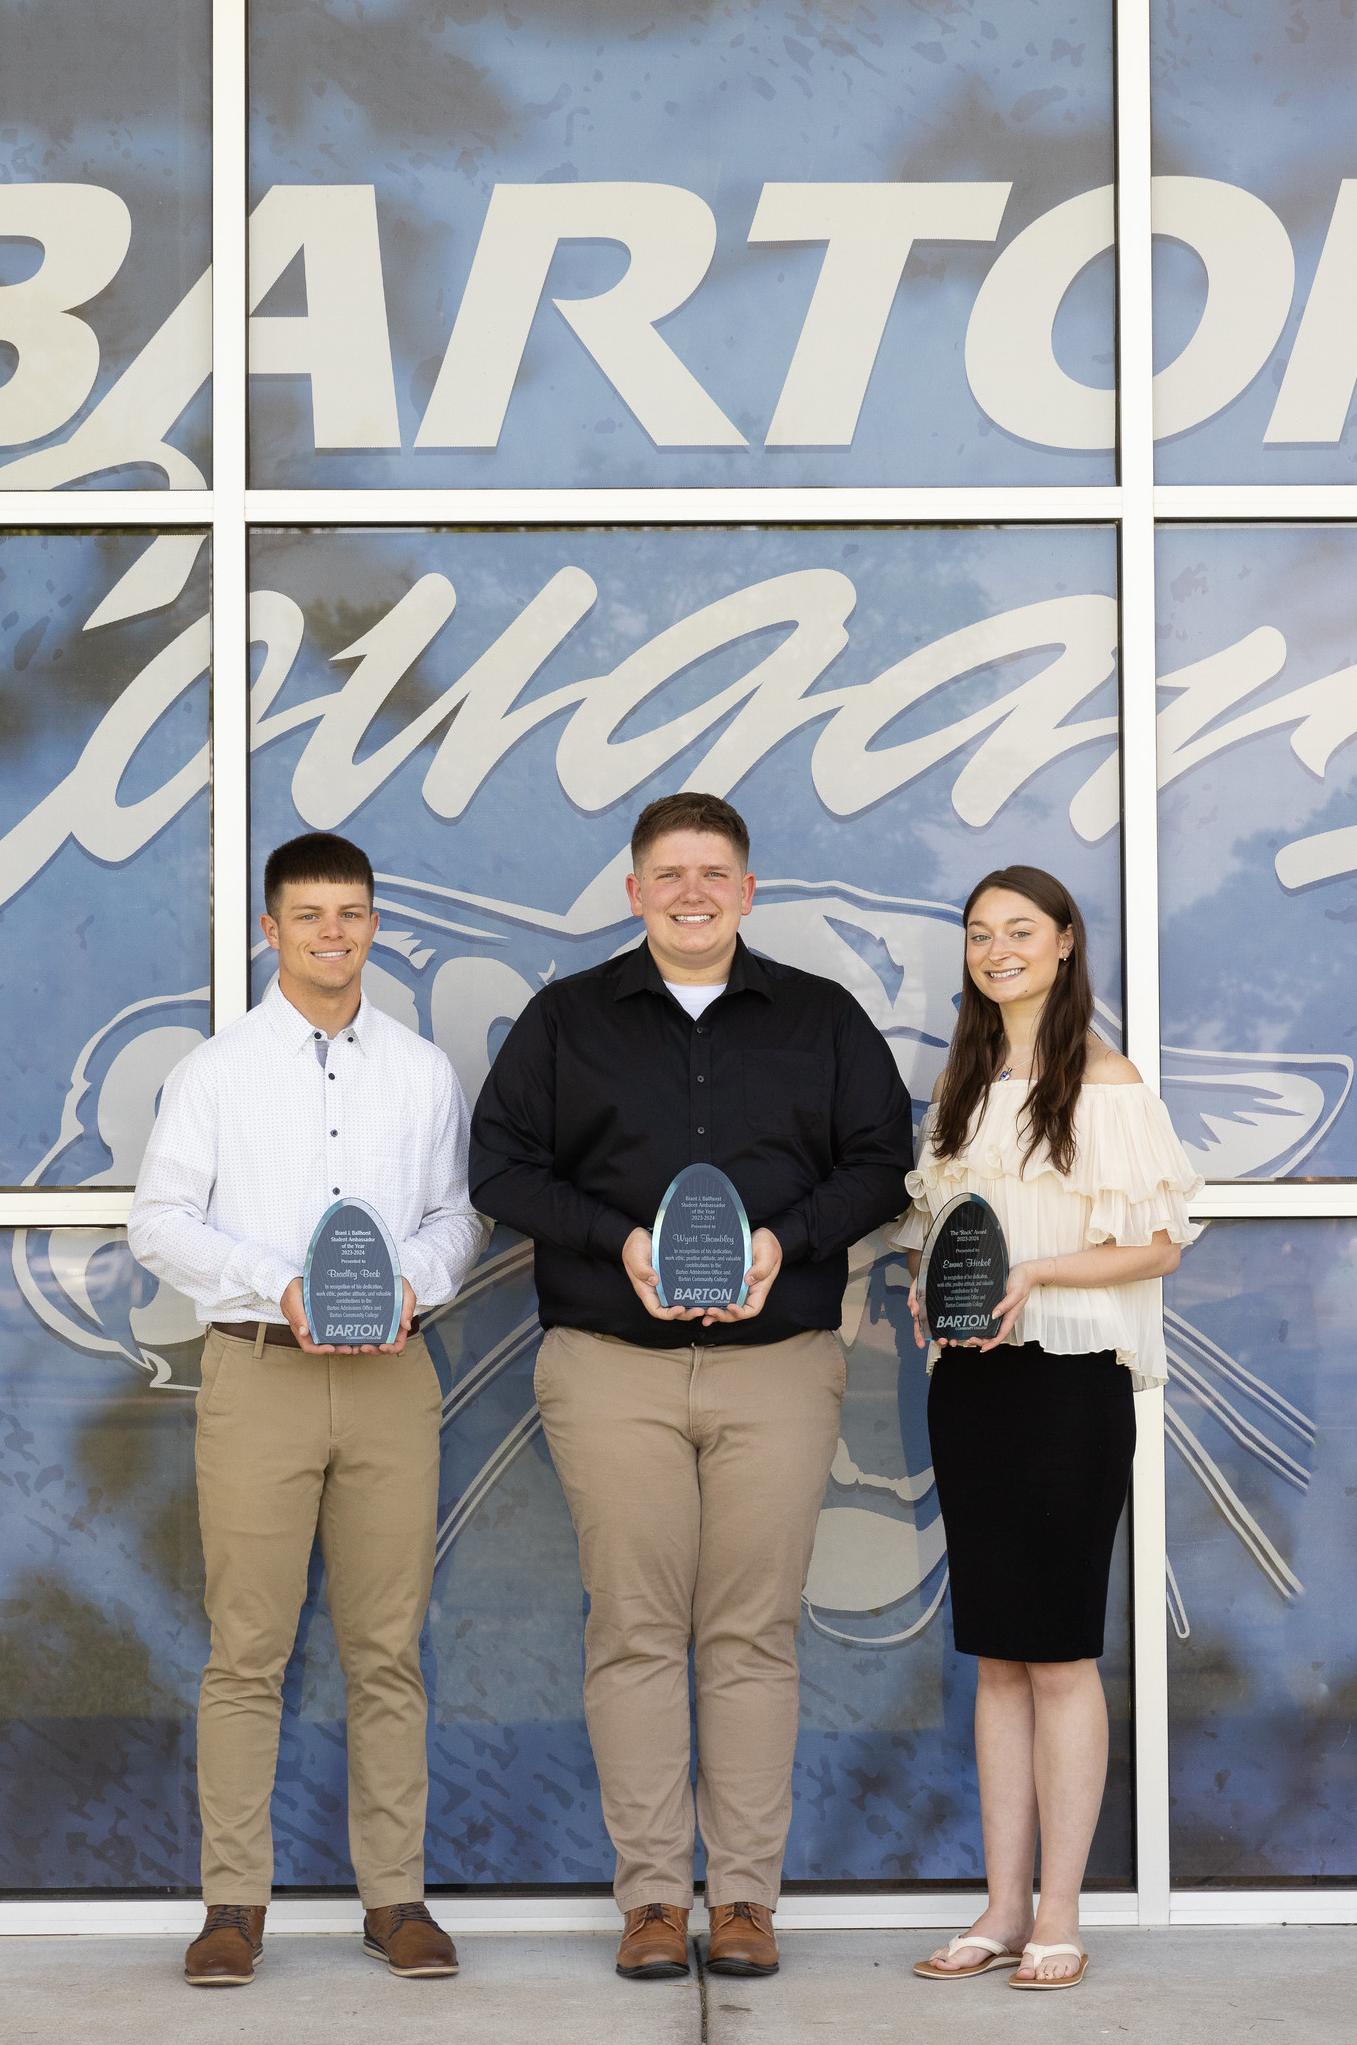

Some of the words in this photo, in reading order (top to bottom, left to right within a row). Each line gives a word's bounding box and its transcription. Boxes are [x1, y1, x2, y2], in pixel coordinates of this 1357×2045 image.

[672, 1234, 697, 1244] Wyatt
[943, 1260, 963, 1269] Emma
[674, 1288, 733, 1300] BARTON
[936, 1314, 990, 1328] BARTON
[326, 1324, 383, 1337] BARTON
